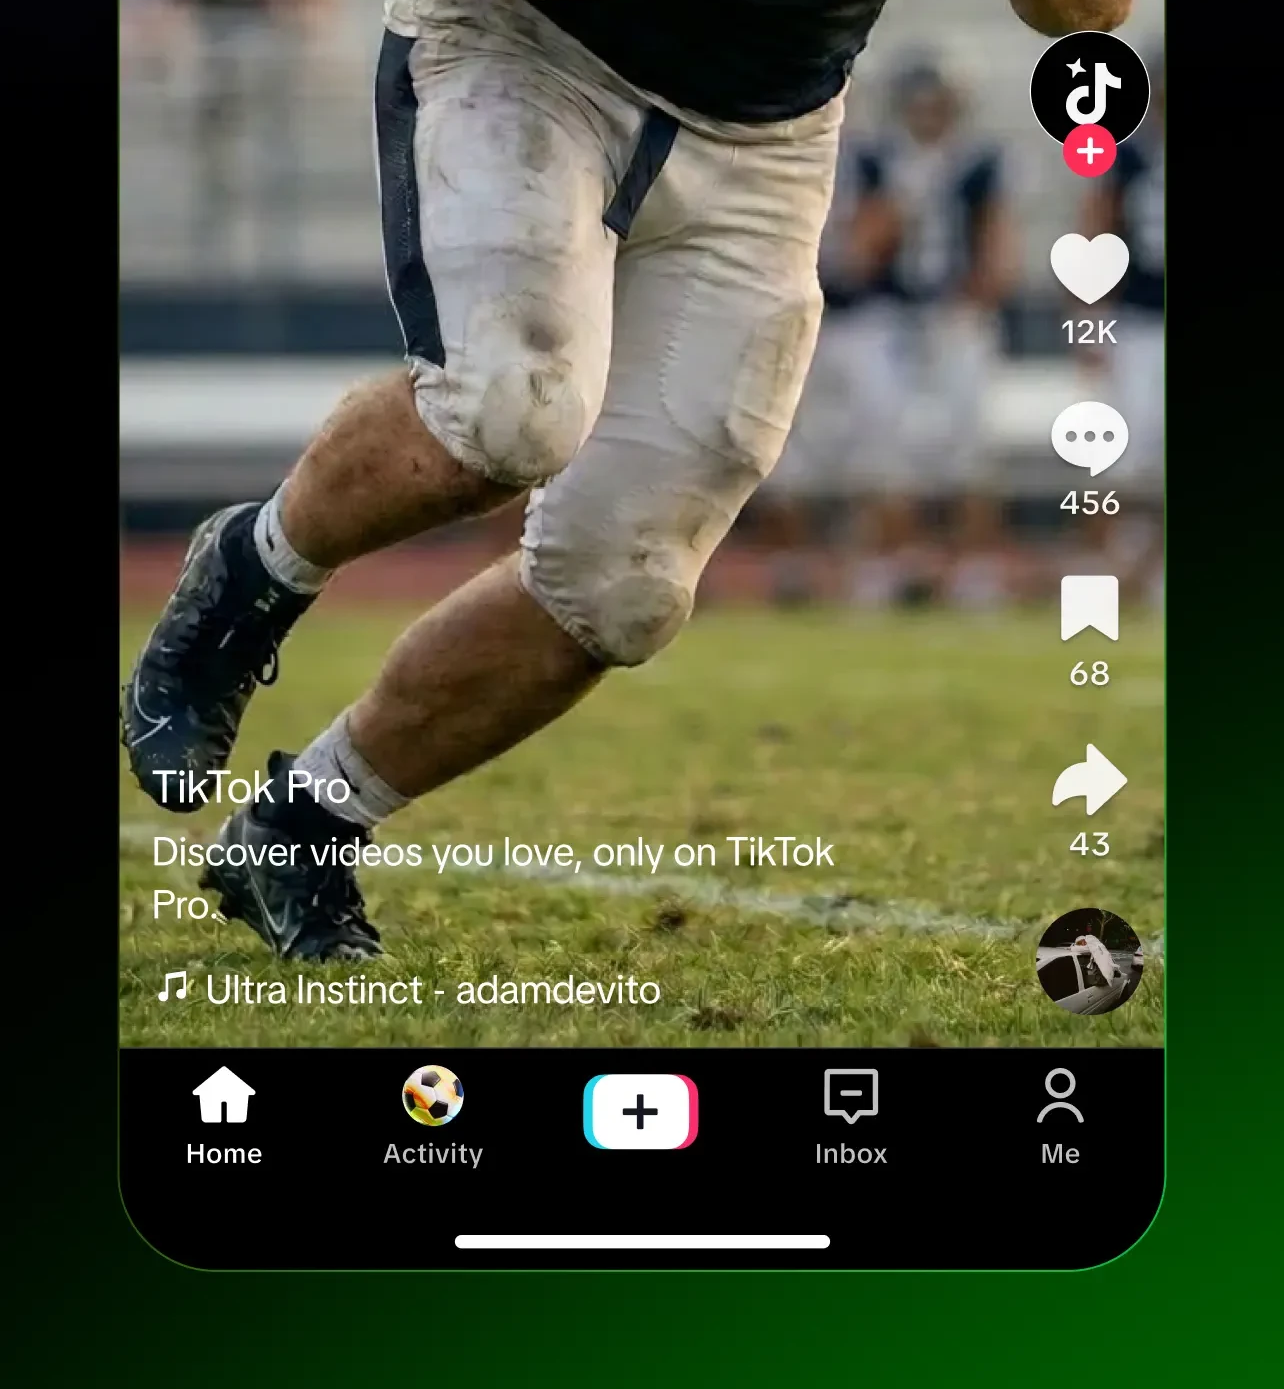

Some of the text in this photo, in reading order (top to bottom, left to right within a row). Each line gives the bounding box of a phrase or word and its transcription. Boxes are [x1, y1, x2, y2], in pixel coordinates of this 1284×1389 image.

[1062, 319, 1119, 345] 12K
[1060, 490, 1121, 515] 456
[1070, 661, 1109, 686] 68
[152, 769, 351, 805] TikTok Pro
[154, 836, 834, 875] Discover videos you love, only on TikTok
[1069, 832, 1110, 856] 43
[153, 889, 217, 920] Pro.
[207, 974, 287, 1004] Ultra
[298, 974, 423, 1004] Instinct
[457, 974, 661, 1004] adamdevito
[187, 1142, 263, 1164] Home
[383, 1142, 484, 1169] Activity
[815, 1142, 888, 1164] Inbox
[1042, 1142, 1080, 1164] Me
